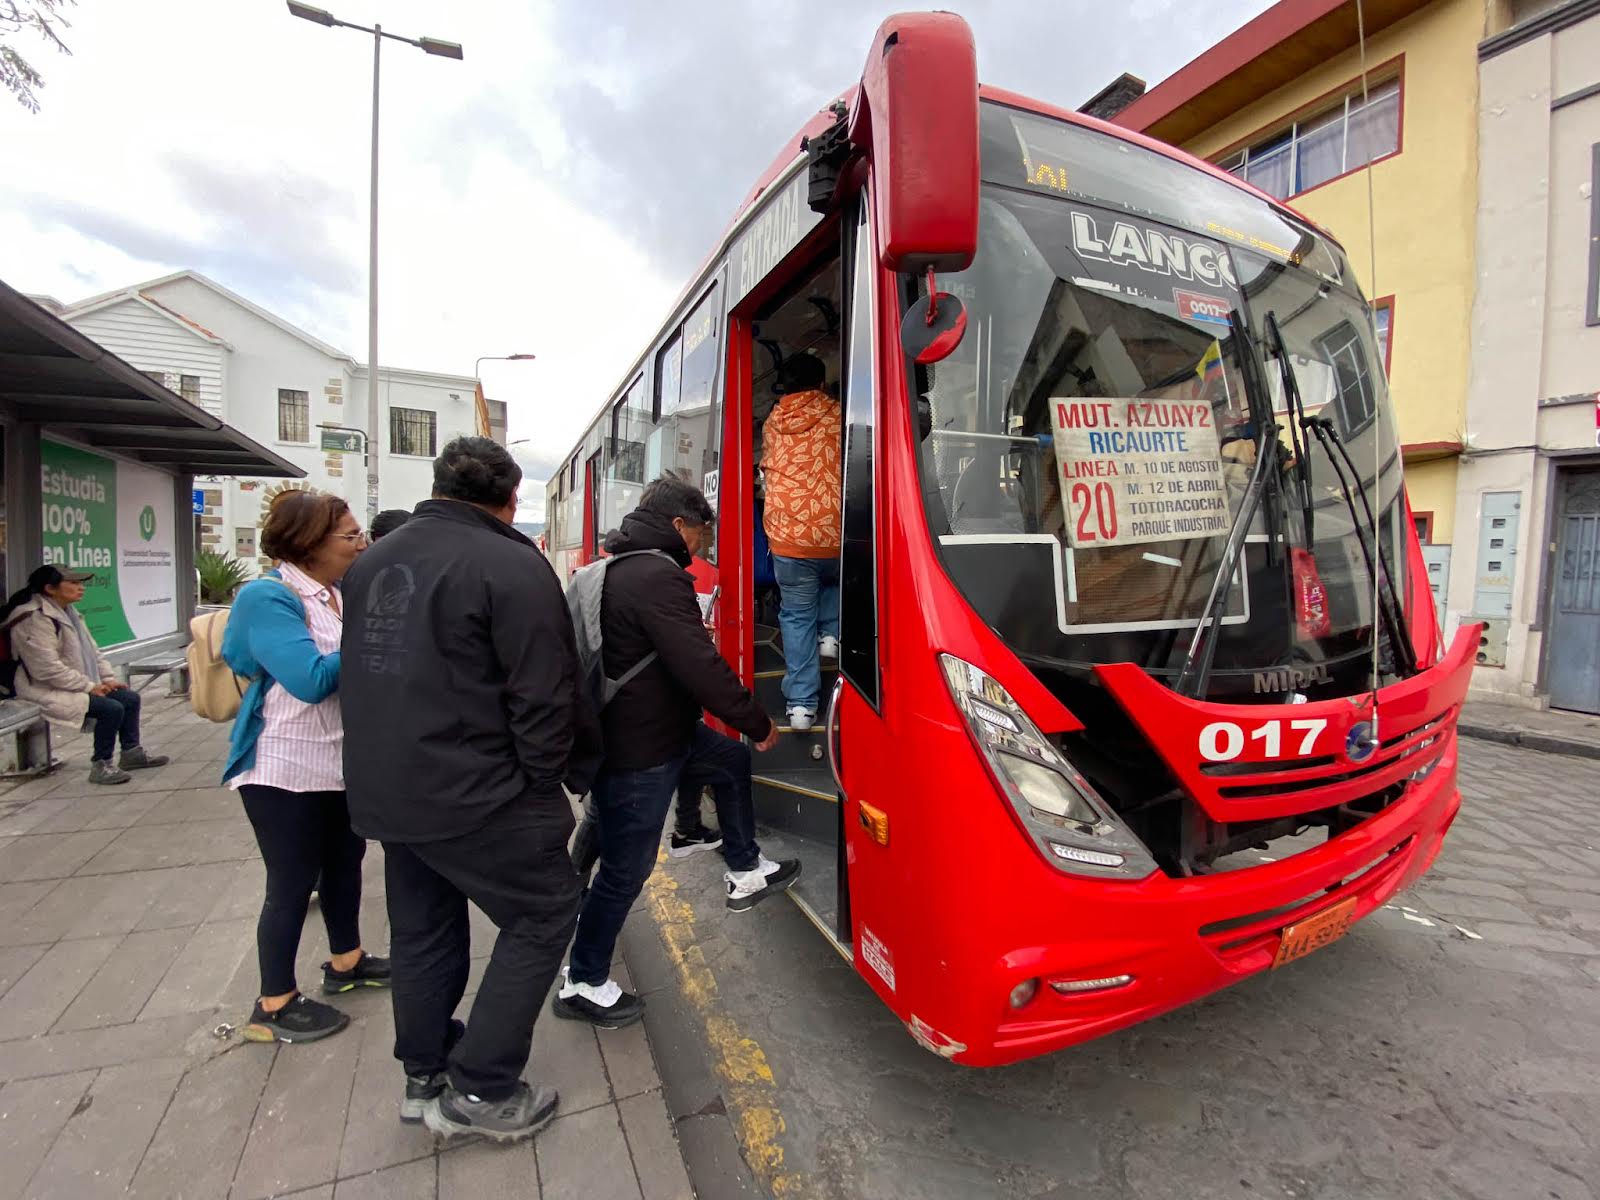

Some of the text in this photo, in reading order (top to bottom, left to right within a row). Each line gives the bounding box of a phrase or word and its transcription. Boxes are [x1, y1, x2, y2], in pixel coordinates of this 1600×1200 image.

[741, 178, 799, 297] ENTRADA
[1057, 403, 1119, 429] MUT.
[1089, 431, 1189, 454] RICAURTE
[1063, 460, 1119, 479] LINEA
[1124, 460, 1219, 475] M. 10 DE AGOSTO
[41, 464, 106, 503] Estudia
[705, 473, 718, 494] NO
[1150, 481, 1164, 494] 12
[1168, 481, 1184, 493] DE
[1188, 479, 1223, 492] ABRIL
[42, 503, 91, 535] 100%
[1071, 481, 1118, 541] 20
[1129, 498, 1225, 515] TOTORACOCHA
[1132, 516, 1229, 536] PARQUE INDUSTRIAL
[43, 538, 111, 567] en Línea
[1254, 664, 1334, 693] MIRAL
[1198, 719, 1327, 761] 017
